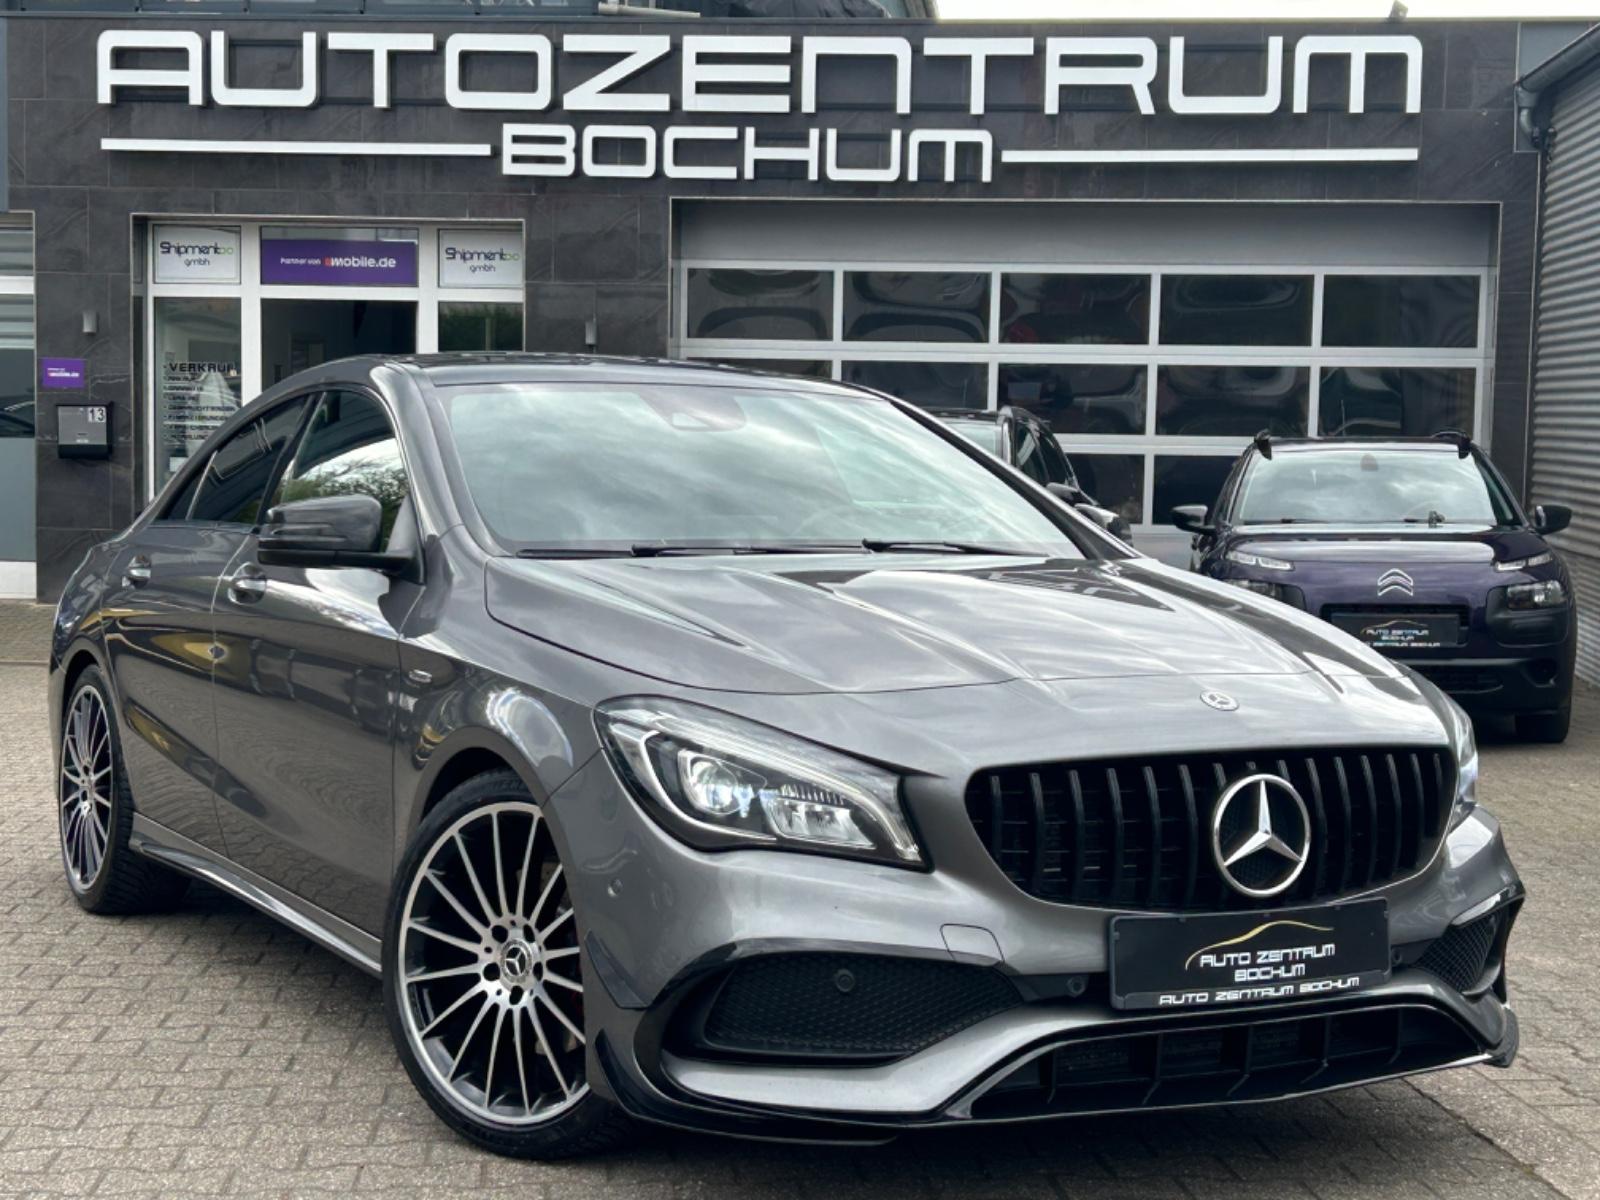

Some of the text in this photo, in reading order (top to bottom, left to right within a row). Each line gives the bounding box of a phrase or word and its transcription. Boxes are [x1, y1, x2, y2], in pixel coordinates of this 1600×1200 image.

[97, 29, 1423, 115] AUTOZENTRUM
[502, 123, 993, 182] BOCHUM
[89, 407, 105, 422] 13
[1200, 943, 1336, 968] AUTO ZENTRUM
[1234, 962, 1306, 982] BOCHUM
[1158, 976, 1360, 1005] AUTO ZENTRUM BOCHUM
